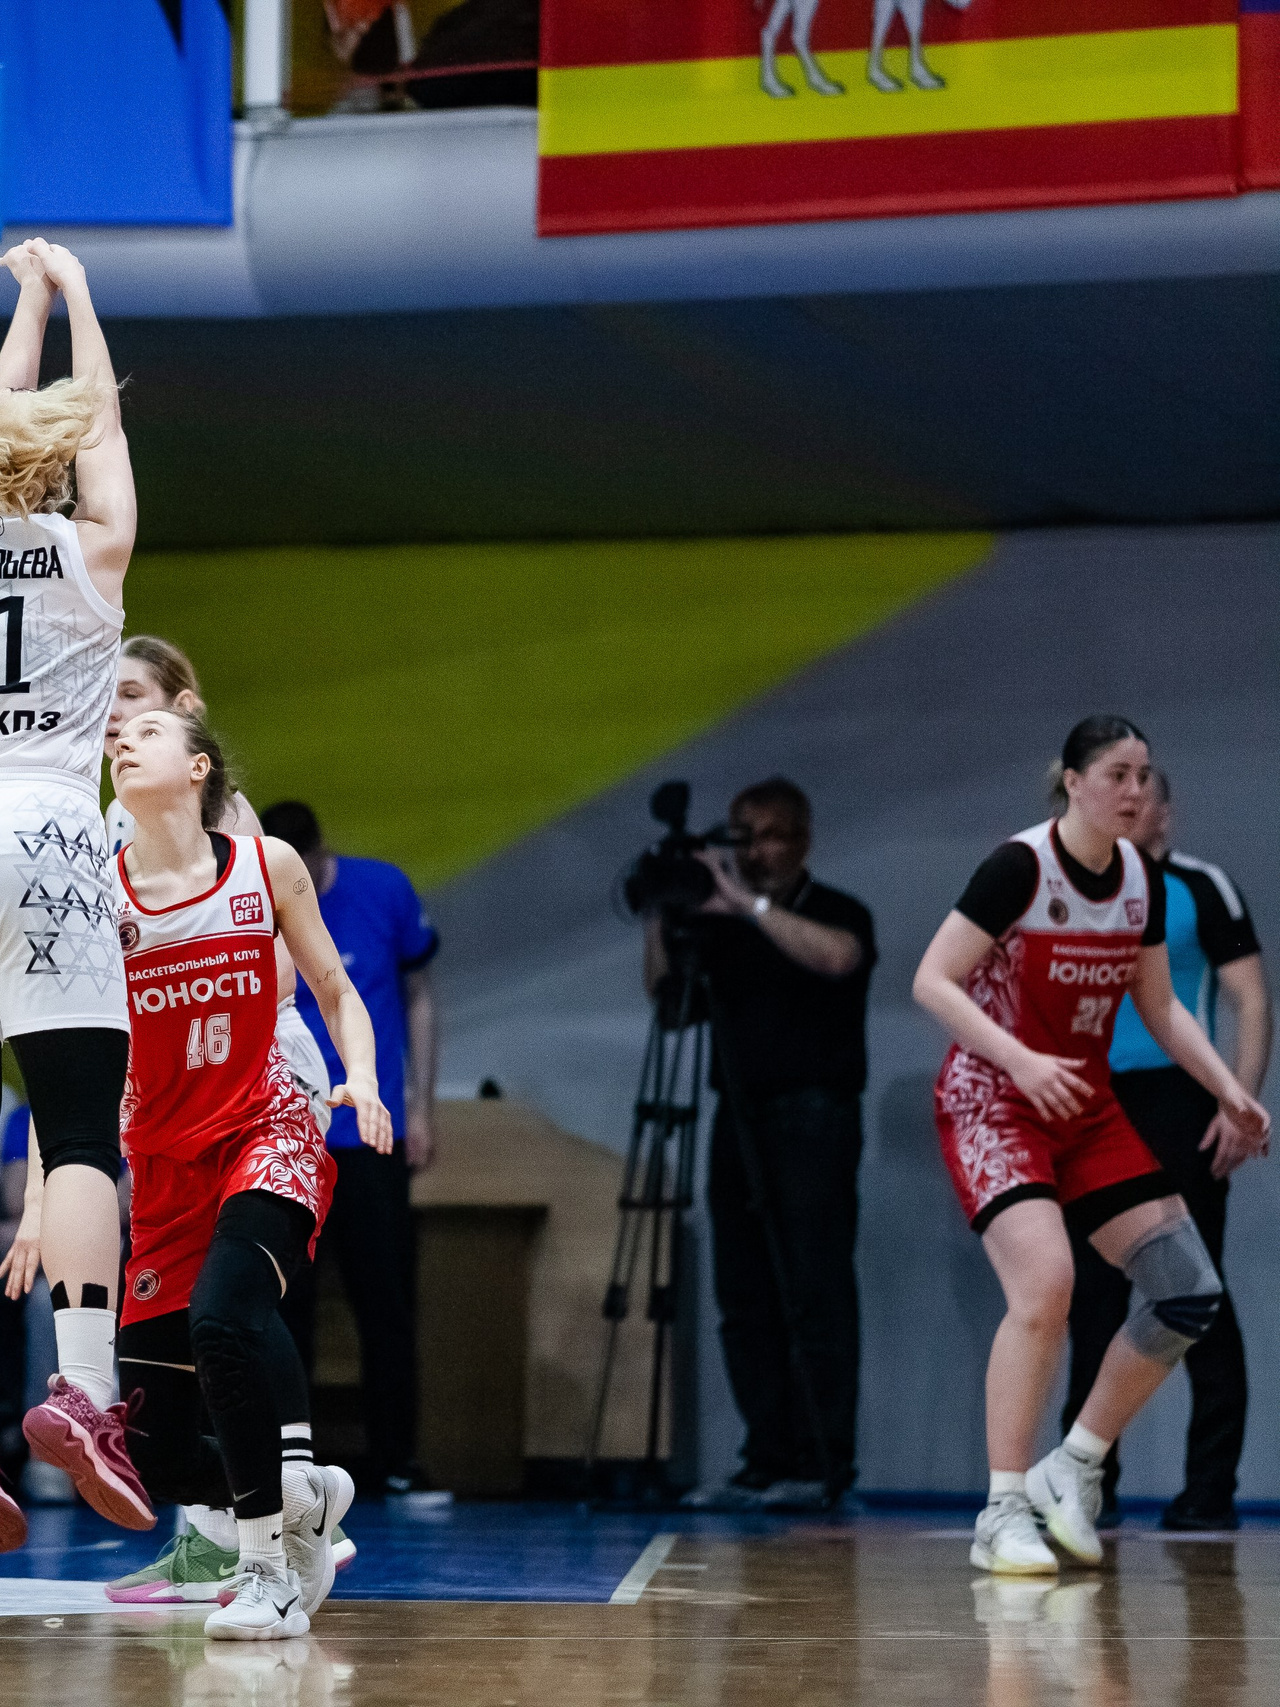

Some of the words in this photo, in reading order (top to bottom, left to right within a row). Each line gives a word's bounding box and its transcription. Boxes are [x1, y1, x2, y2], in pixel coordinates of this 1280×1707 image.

[232, 896, 259, 911] FON
[234, 907, 261, 923] BET
[128, 952, 229, 981] БАСКЕТБОЛЬНЫЙ
[233, 949, 260, 963] КЛУБ
[1047, 960, 1133, 985] ЮНОС
[132, 970, 262, 1015] ЮНОСТЬ
[186, 1013, 231, 1070] 46
